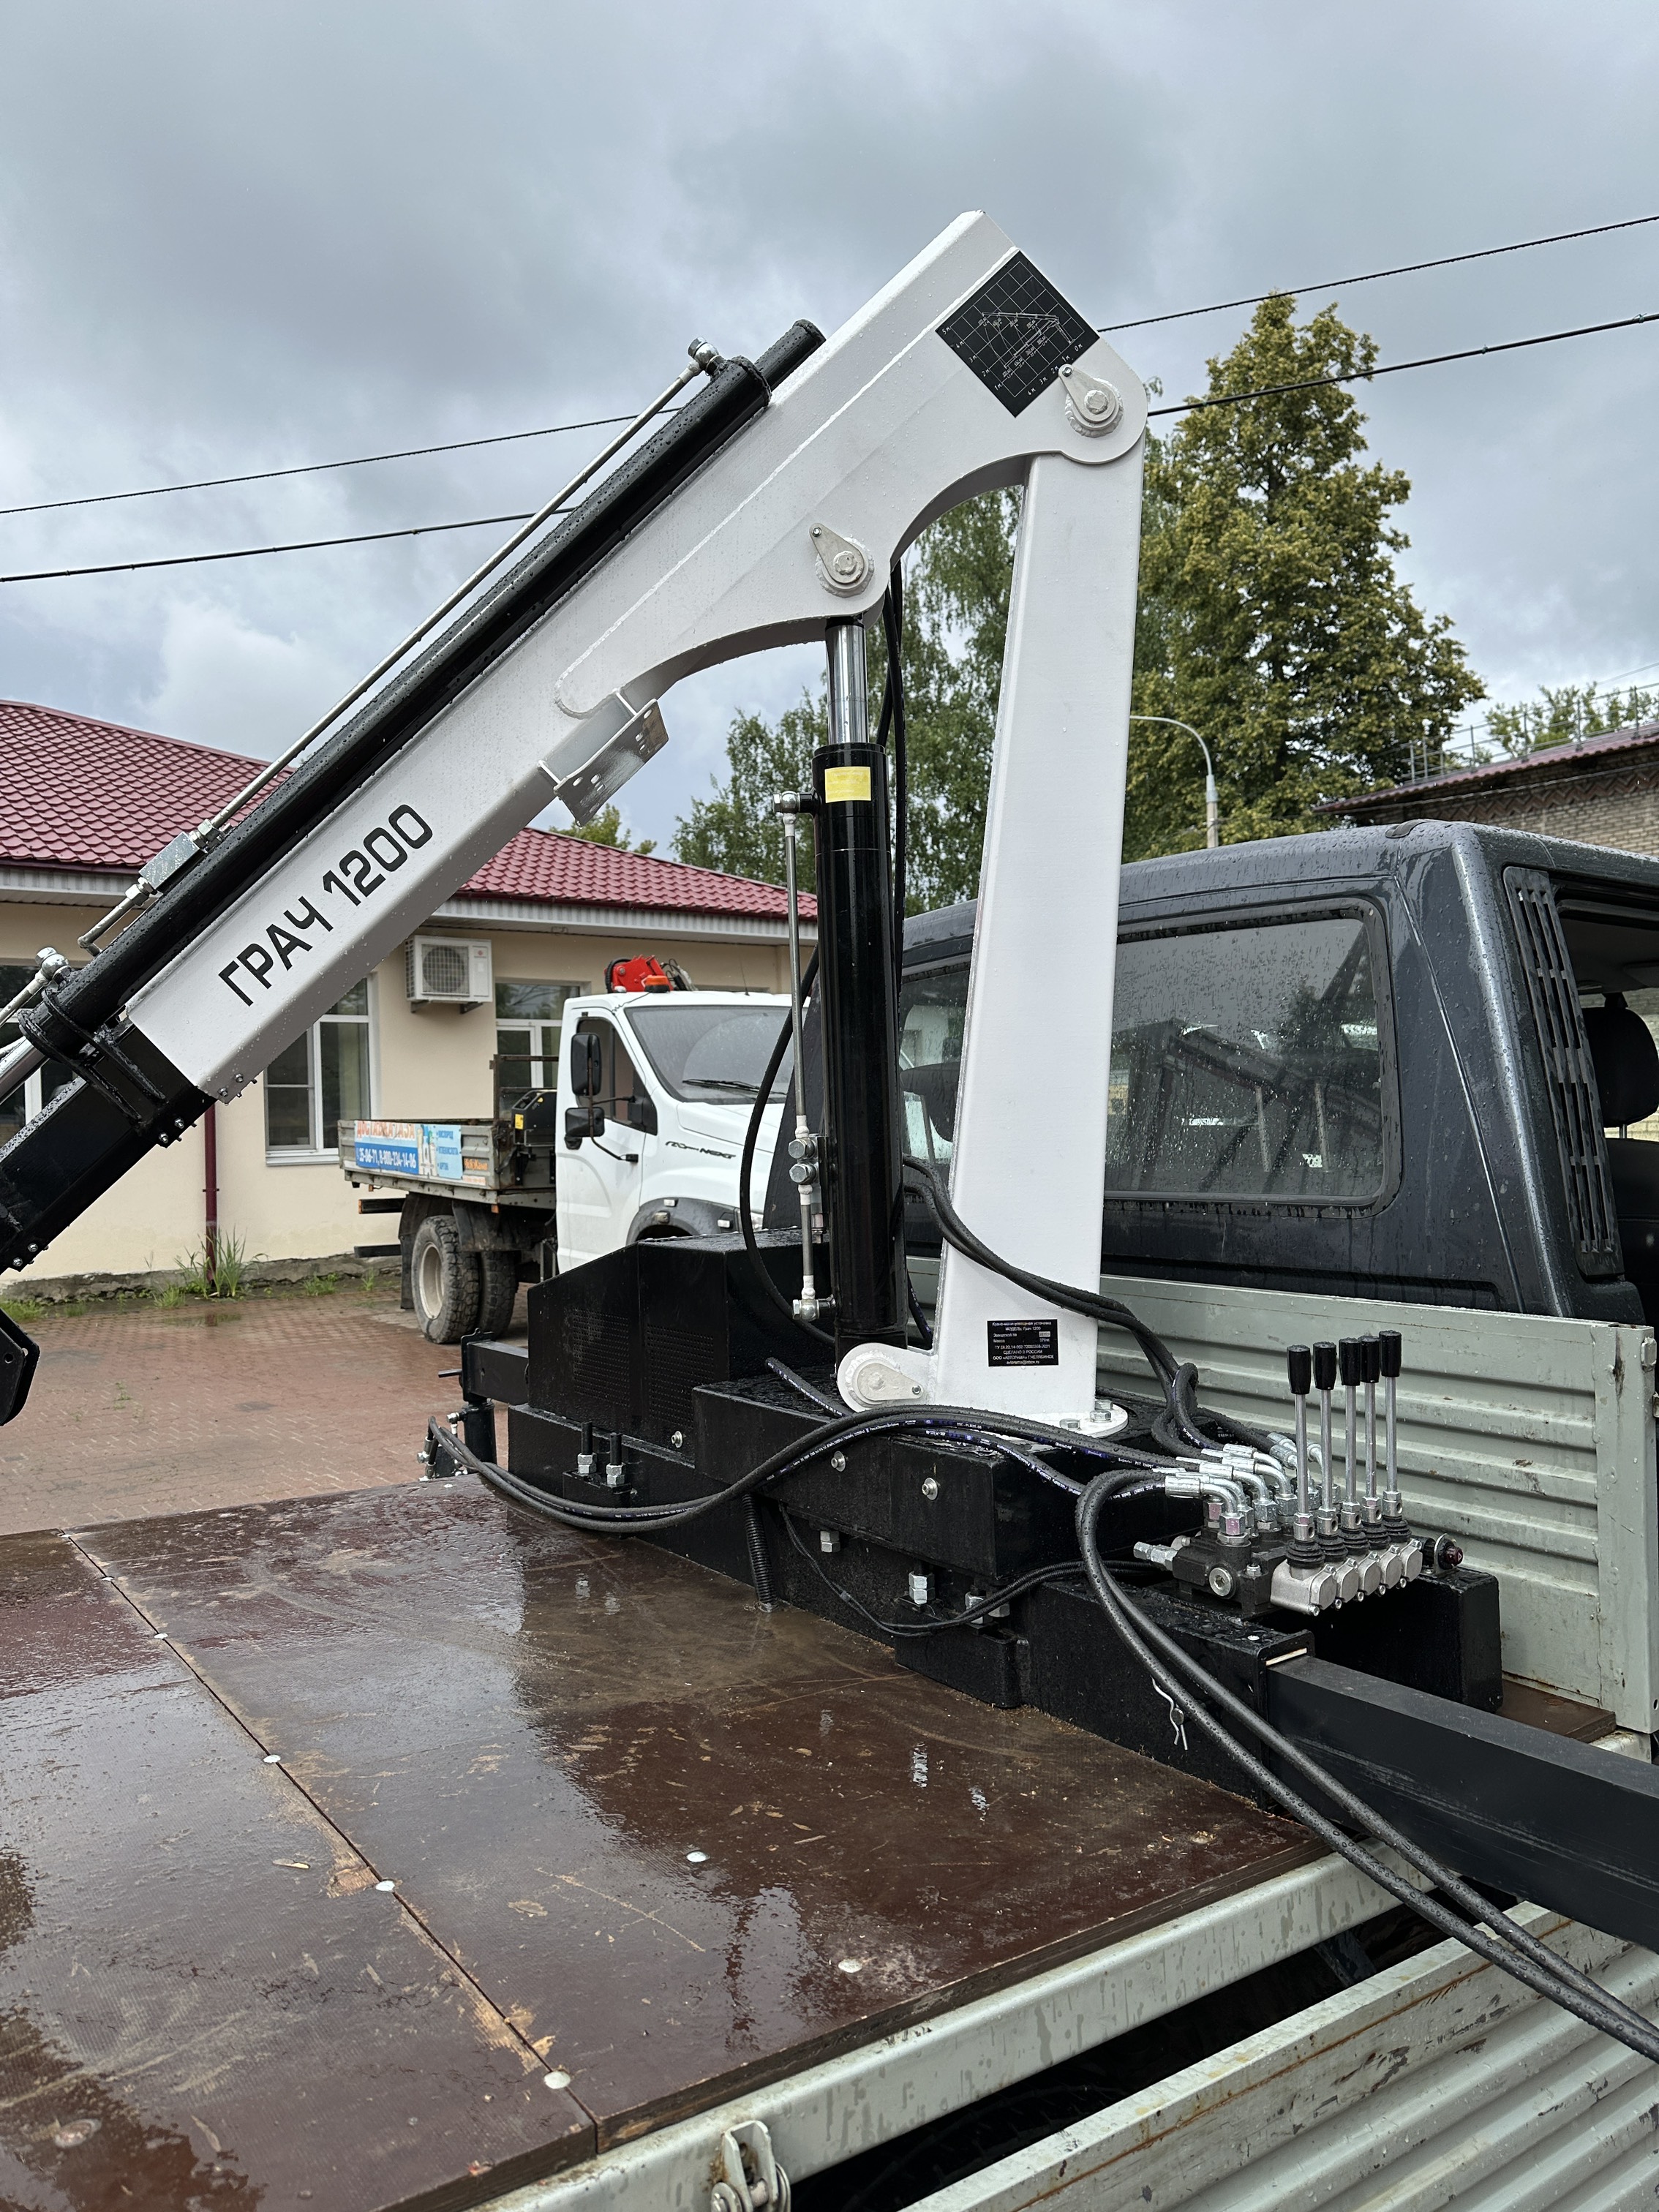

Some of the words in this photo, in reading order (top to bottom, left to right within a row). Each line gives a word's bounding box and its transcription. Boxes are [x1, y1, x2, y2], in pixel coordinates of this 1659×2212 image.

[218, 895, 334, 1007] ГРАЧ
[322, 804, 433, 907] 1200
[699, 1148, 737, 1159] NEXT
